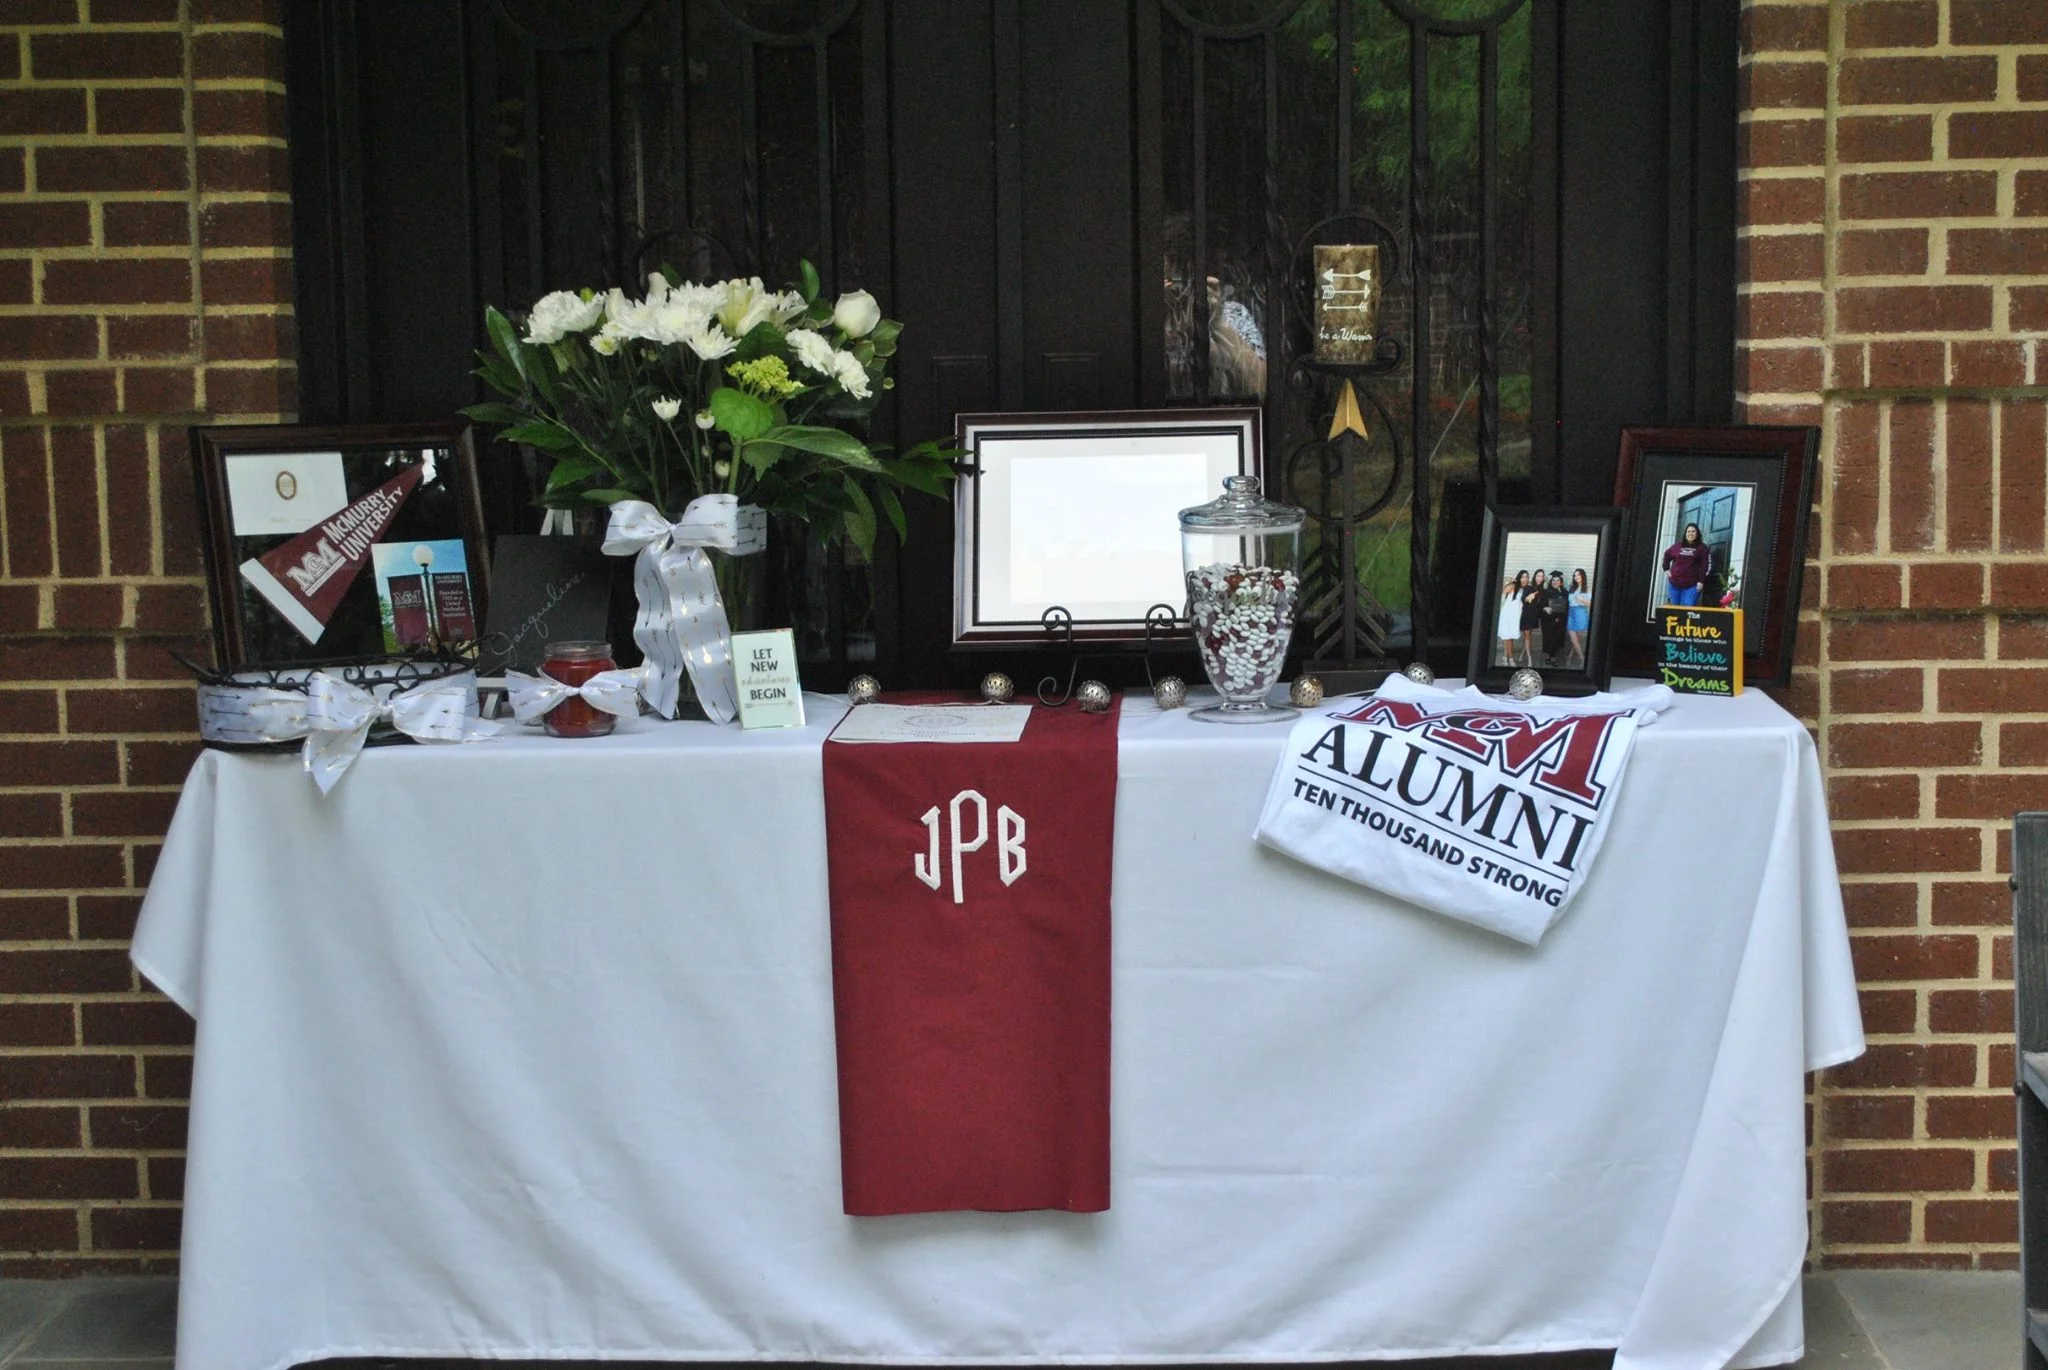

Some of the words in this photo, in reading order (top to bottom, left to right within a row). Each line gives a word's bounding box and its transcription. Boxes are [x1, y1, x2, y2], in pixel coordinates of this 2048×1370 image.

[1319, 326, 1331, 340] be
[340, 486, 404, 561] UNIVERSITY
[1666, 615, 1722, 639] Future
[753, 648, 773, 660] LET
[1665, 642, 1727, 664] Believe
[750, 660, 778, 673] NEW
[1678, 663, 1702, 671] beauty
[1660, 667, 1730, 692] Dreams
[750, 687, 787, 701] BEGIN
[1300, 723, 1595, 873] ALUMNI
[1293, 777, 1336, 811] TEN
[1340, 795, 1465, 866] THOUSAND
[1466, 855, 1564, 908] STRONG
